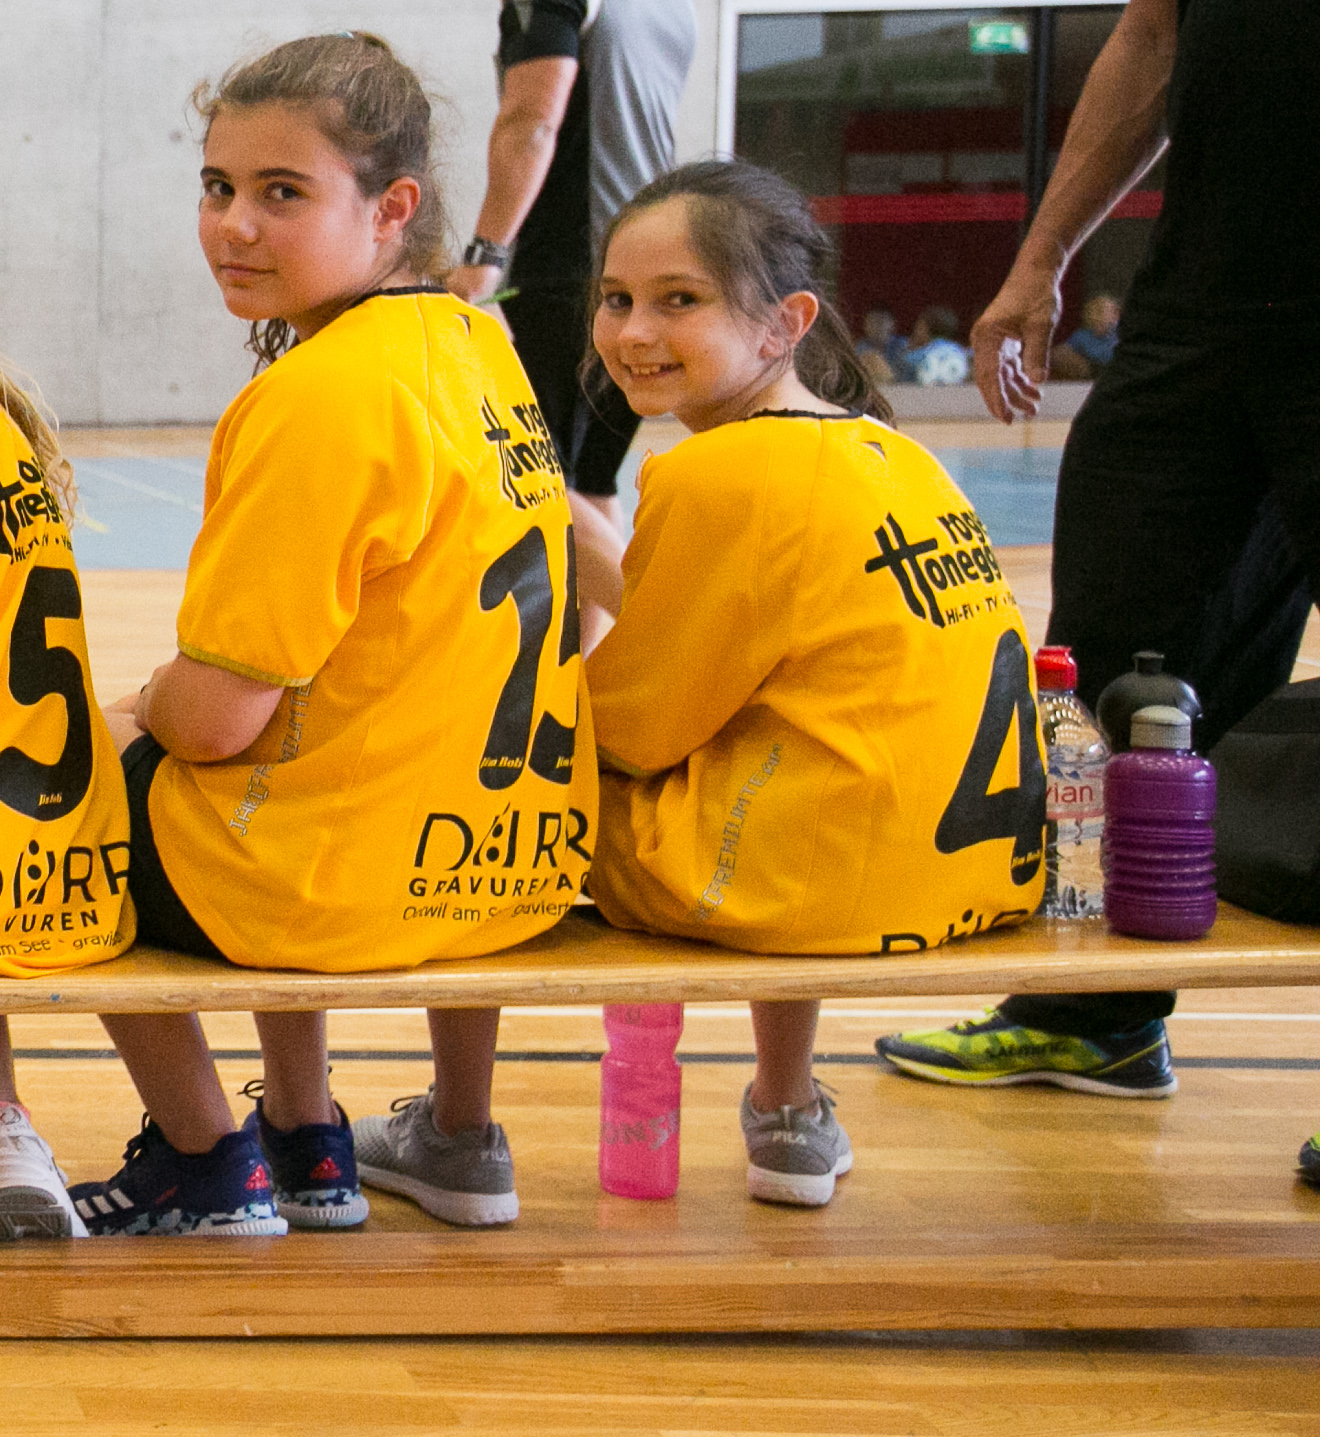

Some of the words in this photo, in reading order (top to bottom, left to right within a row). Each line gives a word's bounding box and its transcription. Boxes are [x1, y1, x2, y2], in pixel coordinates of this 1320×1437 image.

[985, 596, 998, 613] TV
[935, 628, 1047, 886] 4
[1046, 782, 1094, 804] vian
[452, 907, 480, 921] am
[19, 937, 51, 952] See
[771, 1131, 807, 1145] FILA
